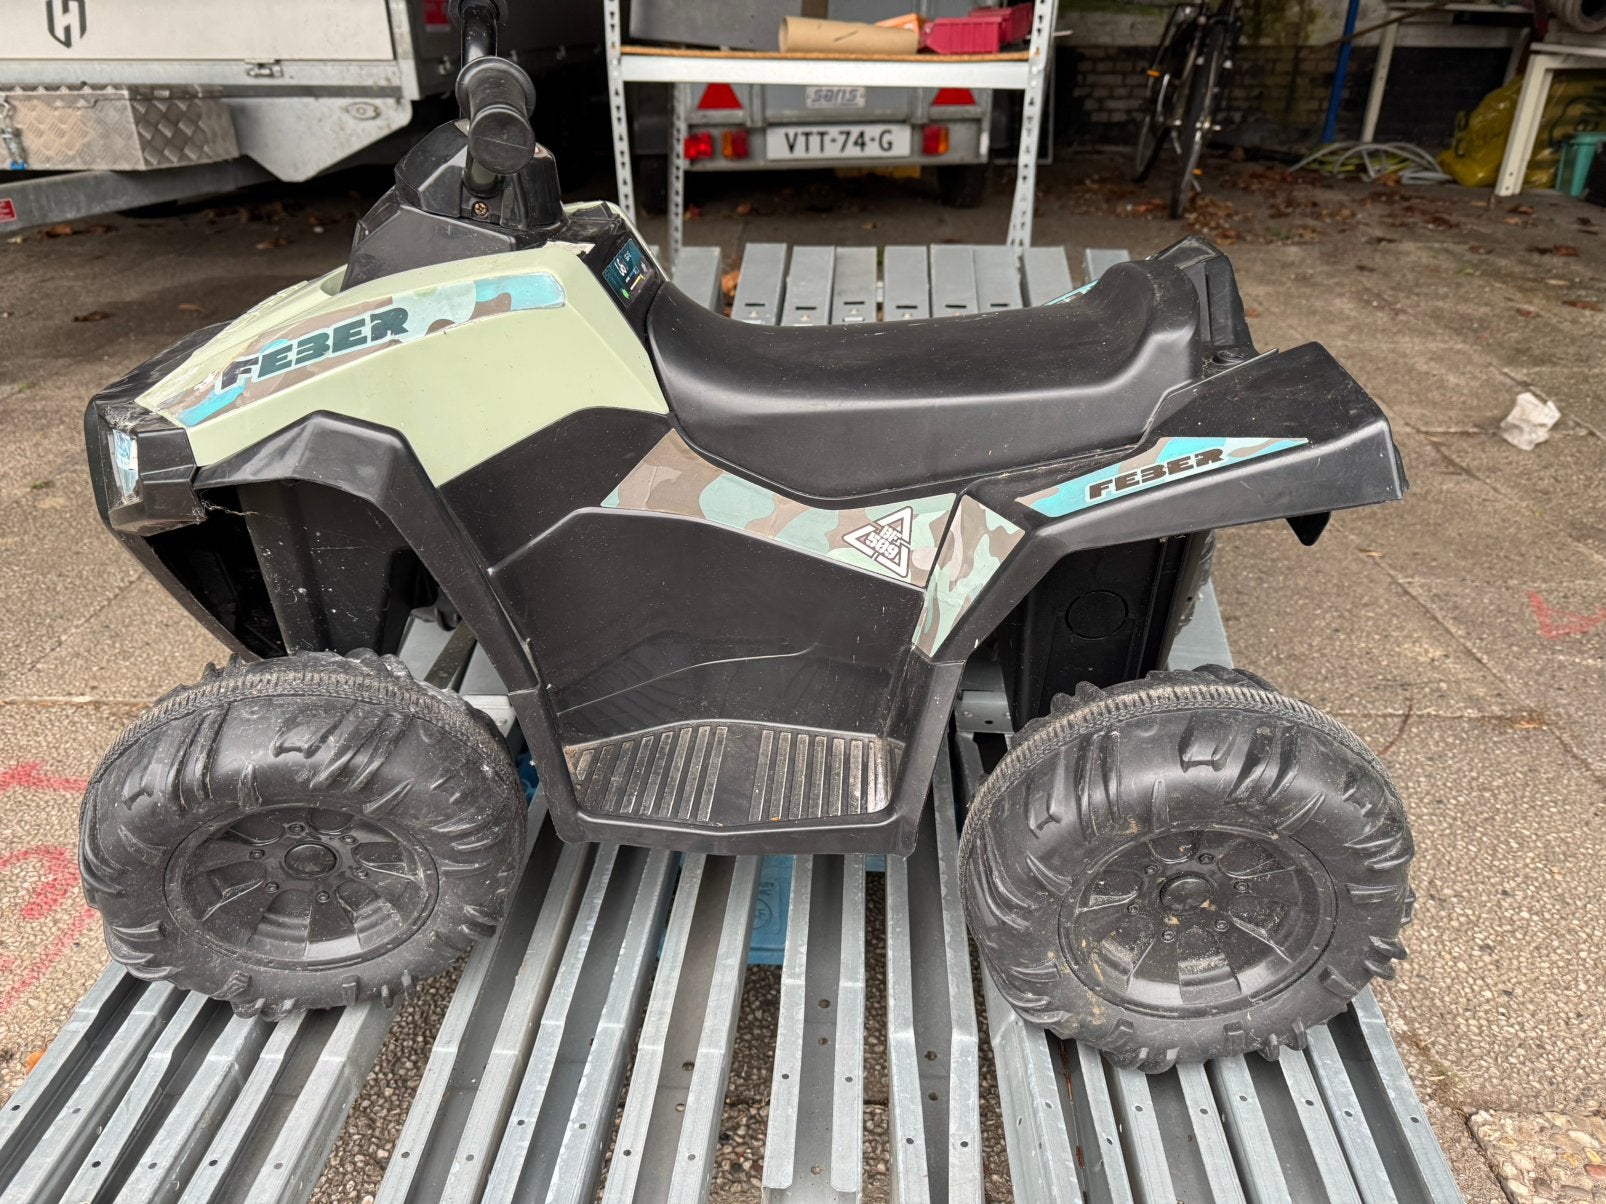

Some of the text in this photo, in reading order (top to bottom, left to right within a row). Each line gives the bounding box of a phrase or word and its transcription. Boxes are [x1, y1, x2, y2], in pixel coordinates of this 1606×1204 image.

[784, 129, 894, 154] VTT-74-G
[221, 307, 409, 390] FEBER
[1089, 448, 1224, 500] FEBER
[866, 532, 900, 558] 509
